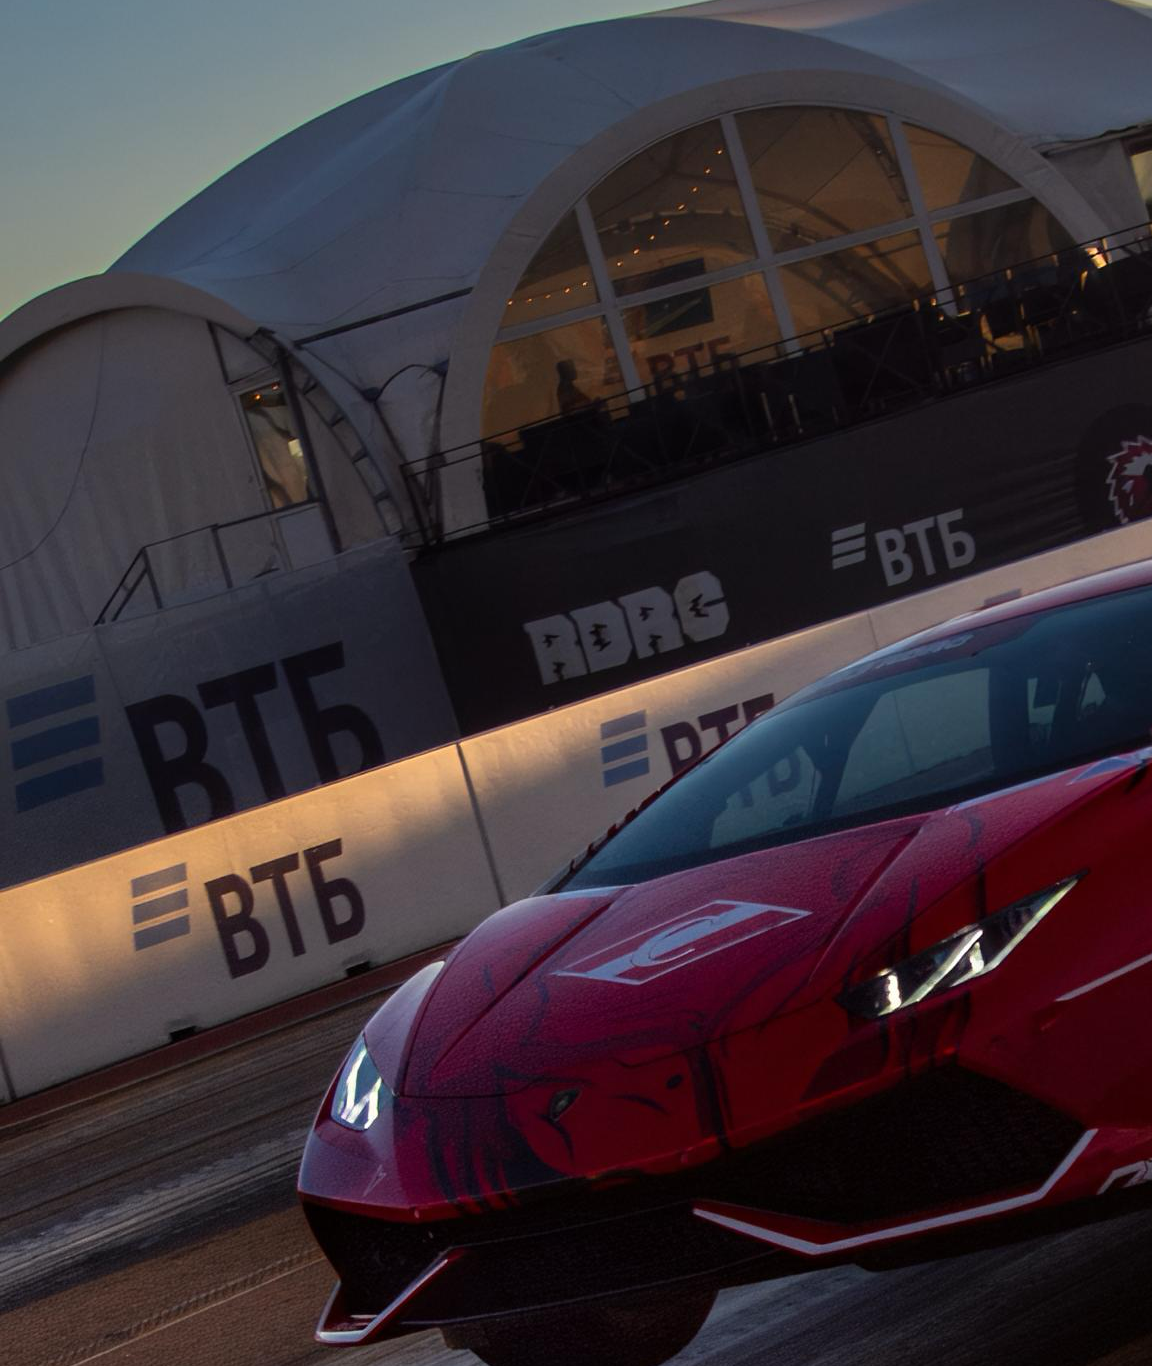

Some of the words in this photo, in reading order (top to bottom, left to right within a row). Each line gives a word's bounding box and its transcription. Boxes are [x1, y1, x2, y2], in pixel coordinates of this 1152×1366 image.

[874, 507, 976, 586] ВТБ
[125, 641, 385, 834] ВТБ
[204, 838, 366, 979] ВТБ
